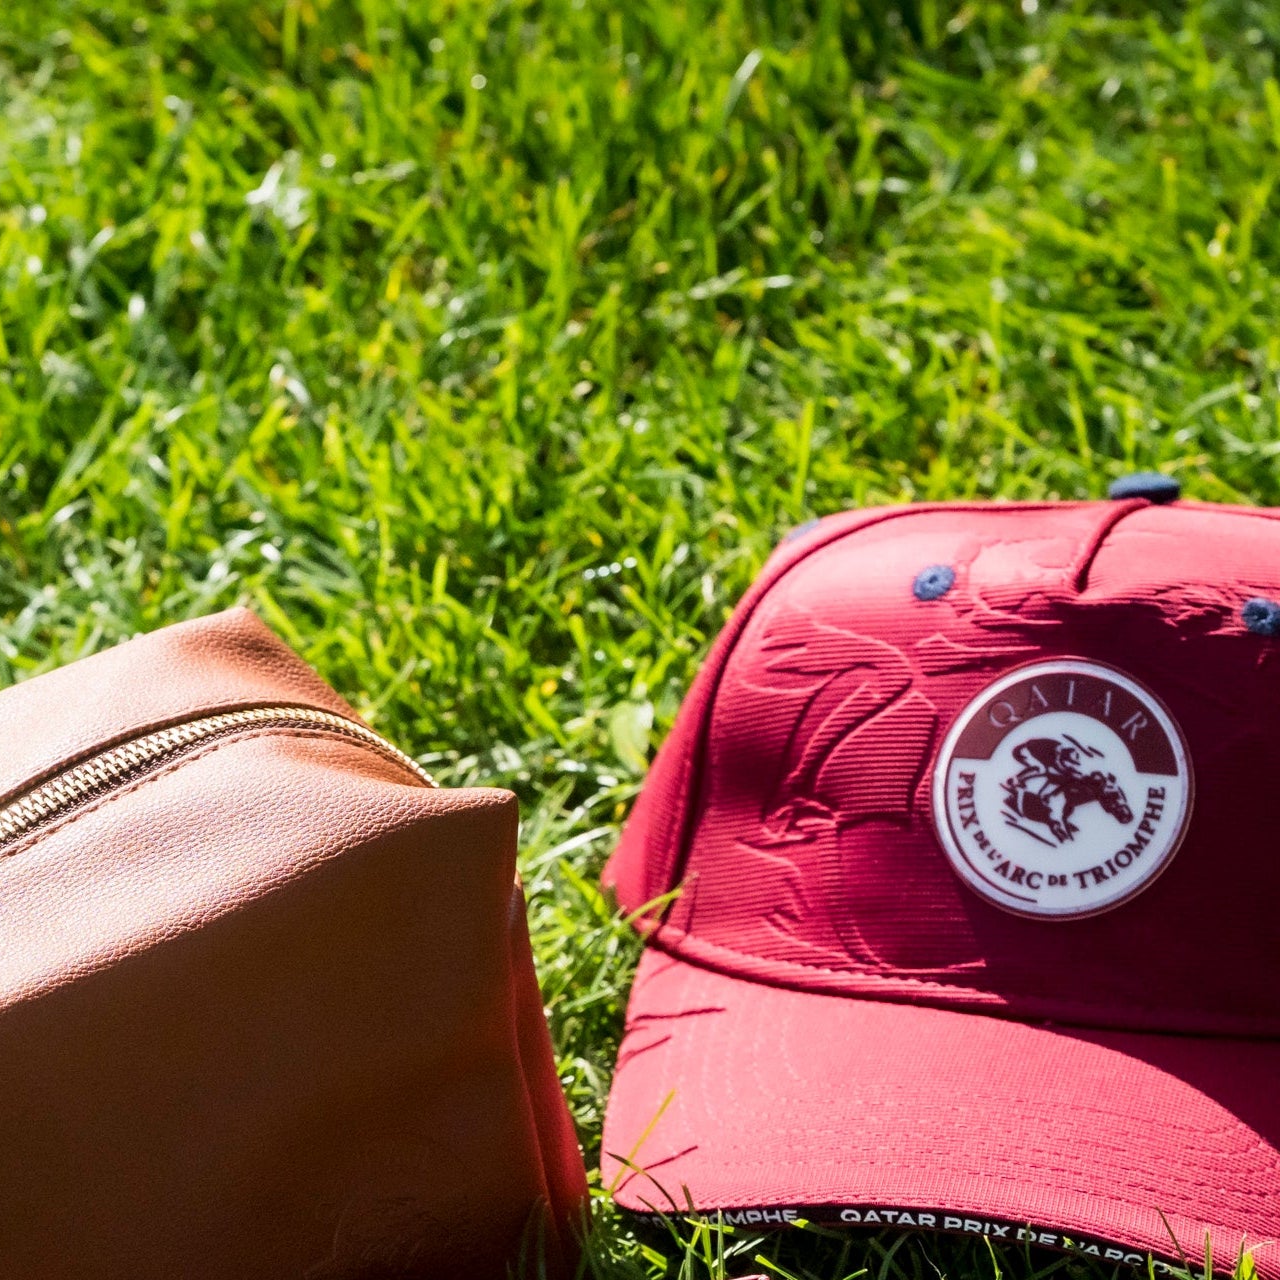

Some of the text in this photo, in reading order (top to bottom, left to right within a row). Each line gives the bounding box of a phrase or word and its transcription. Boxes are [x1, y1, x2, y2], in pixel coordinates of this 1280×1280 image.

[988, 680, 1148, 740] QATAR
[956, 771, 980, 830] PRIX
[1048, 874, 1068, 887] DE
[1073, 785, 1167, 890] TRIOMPHE
[839, 1208, 937, 1228] QATAR
[943, 1216, 1011, 1238] PRIX
[1016, 1227, 1059, 1246] DE
